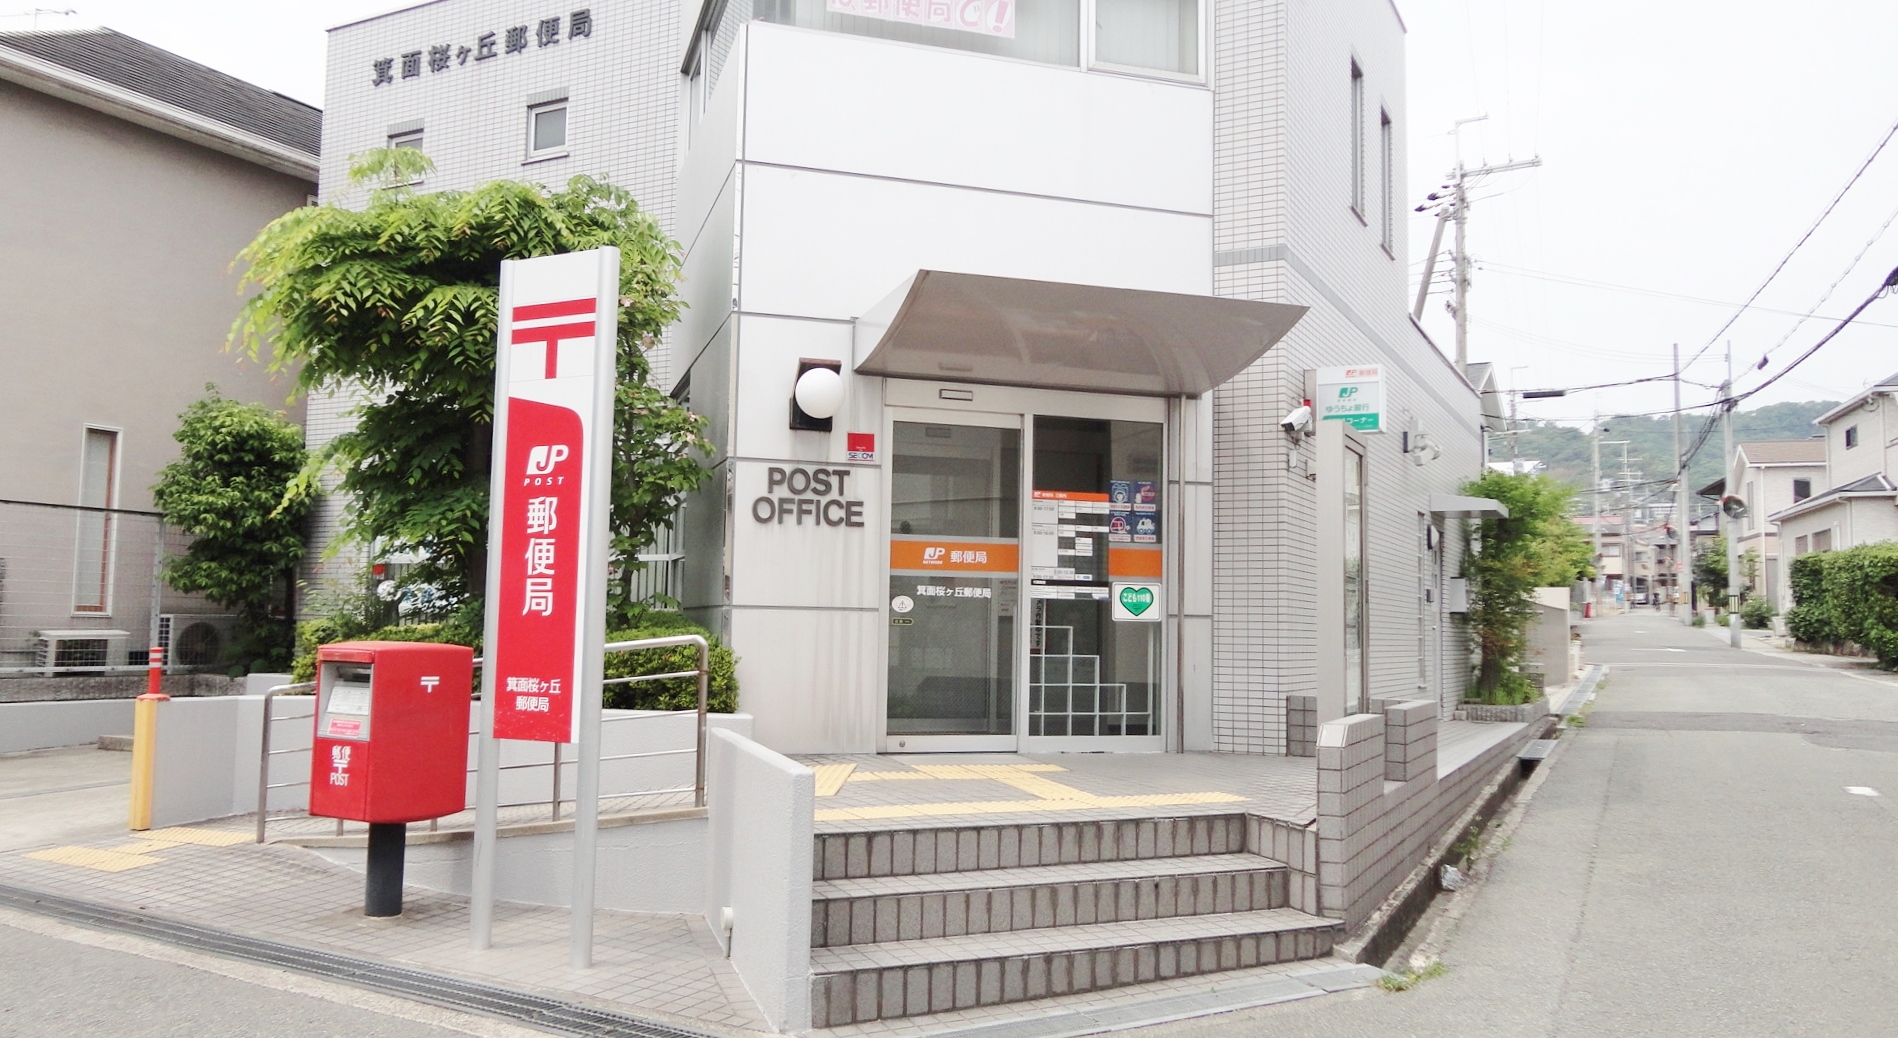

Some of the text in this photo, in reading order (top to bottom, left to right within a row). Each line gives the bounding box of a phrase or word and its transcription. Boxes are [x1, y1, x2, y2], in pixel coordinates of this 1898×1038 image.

[1326, 404, 1369, 413] ゆうちょ銀行
[848, 452, 874, 460] SECOM
[523, 476, 565, 486] POST
[768, 467, 851, 496] POST
[752, 496, 865, 527] OFFICE
[522, 496, 559, 617] 郵便局
[950, 550, 988, 564] 郵便局
[515, 696, 549, 712] 郵便局
[332, 745, 351, 760] 郵便
[330, 773, 349, 786] POST
